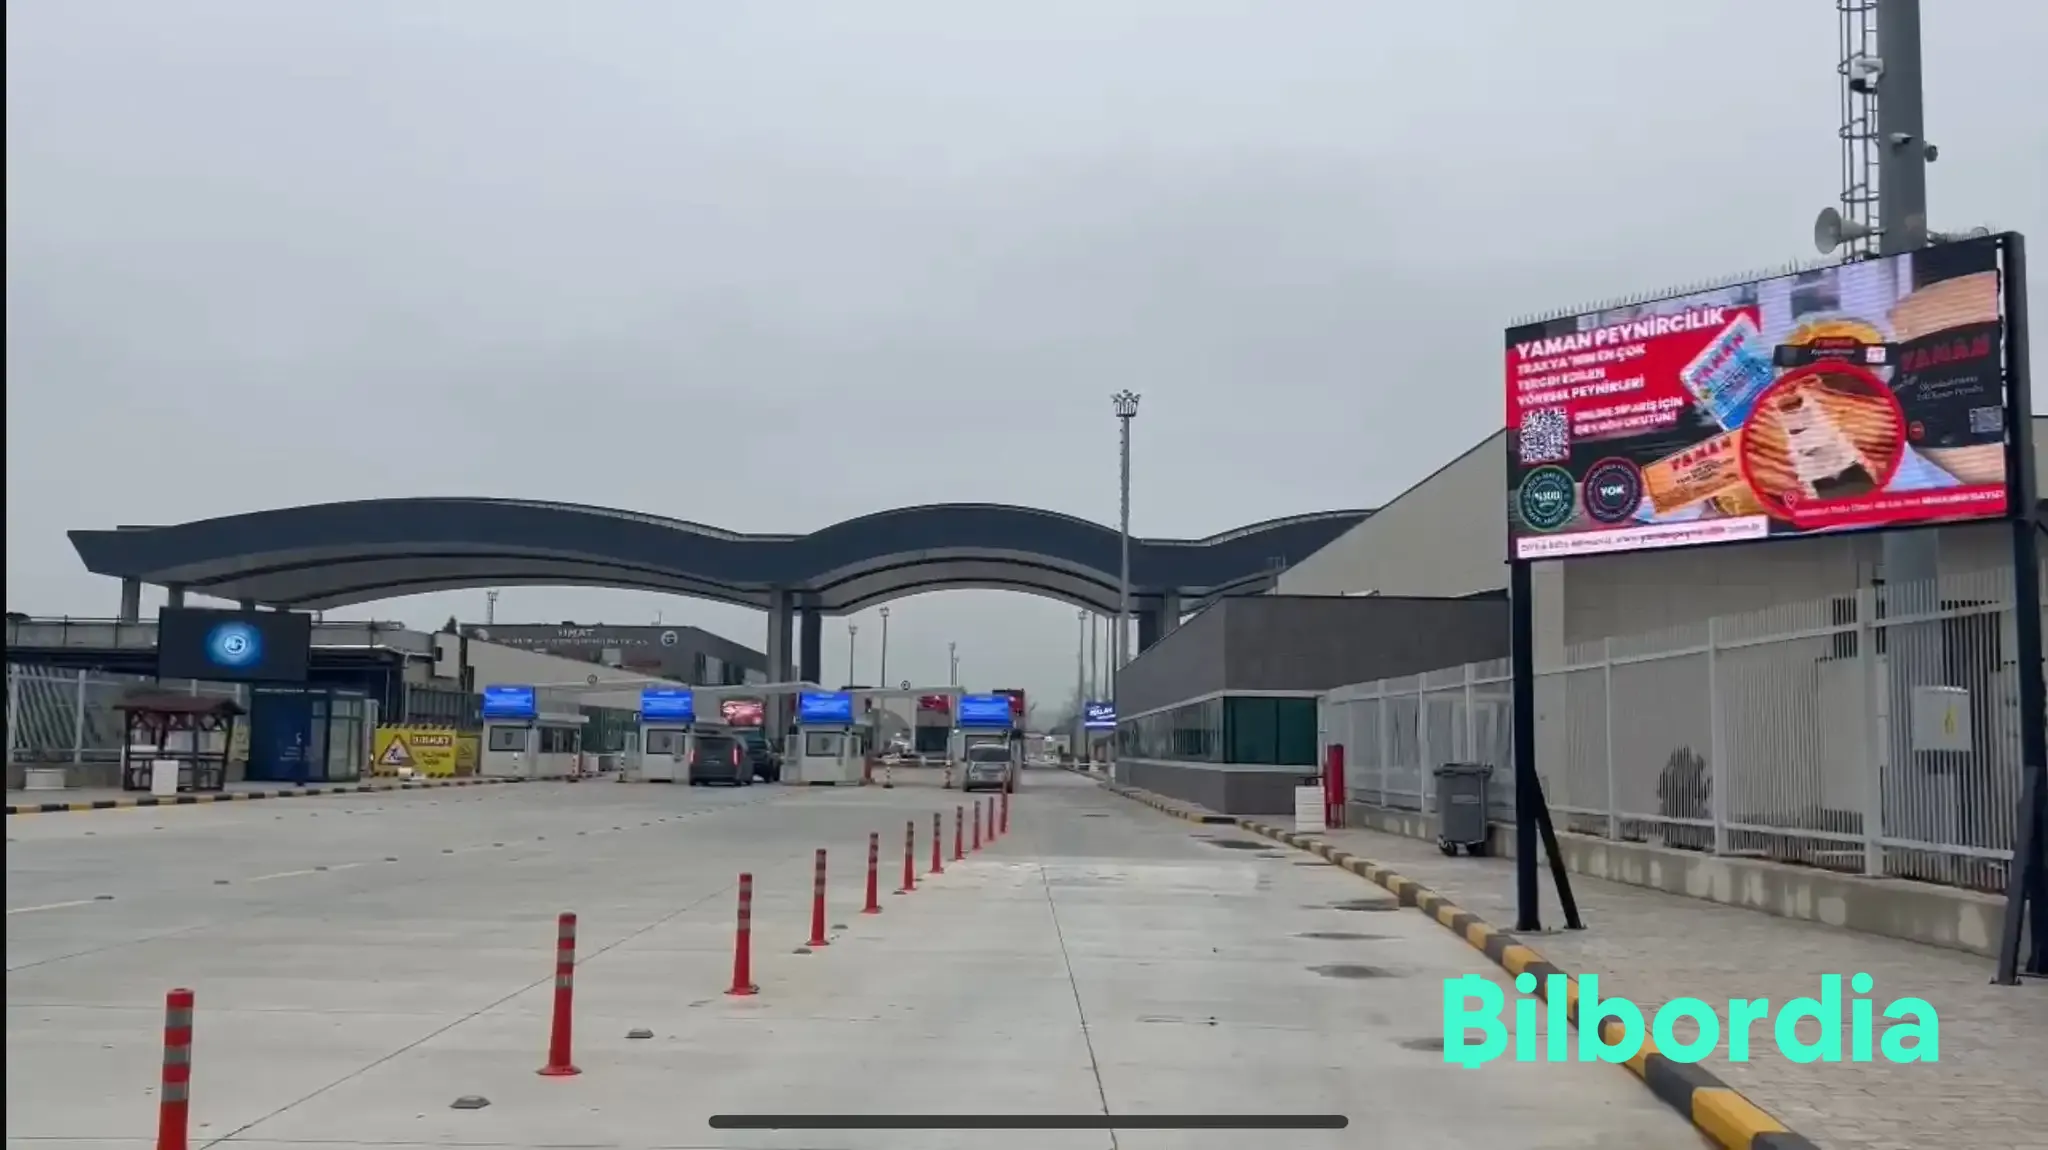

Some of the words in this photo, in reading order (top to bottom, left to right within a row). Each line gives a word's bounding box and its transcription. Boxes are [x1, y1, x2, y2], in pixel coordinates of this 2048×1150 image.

[1516, 331, 1590, 359] YAMAN
[1595, 305, 1725, 345] PEYNİRCİLİK
[1617, 343, 1646, 361] ÇOK
[1902, 333, 1991, 369] YAMAN
[1658, 395, 1684, 411] İÇİN
[1671, 436, 1732, 471] YAMAN
[1600, 486, 1625, 498] YOK
